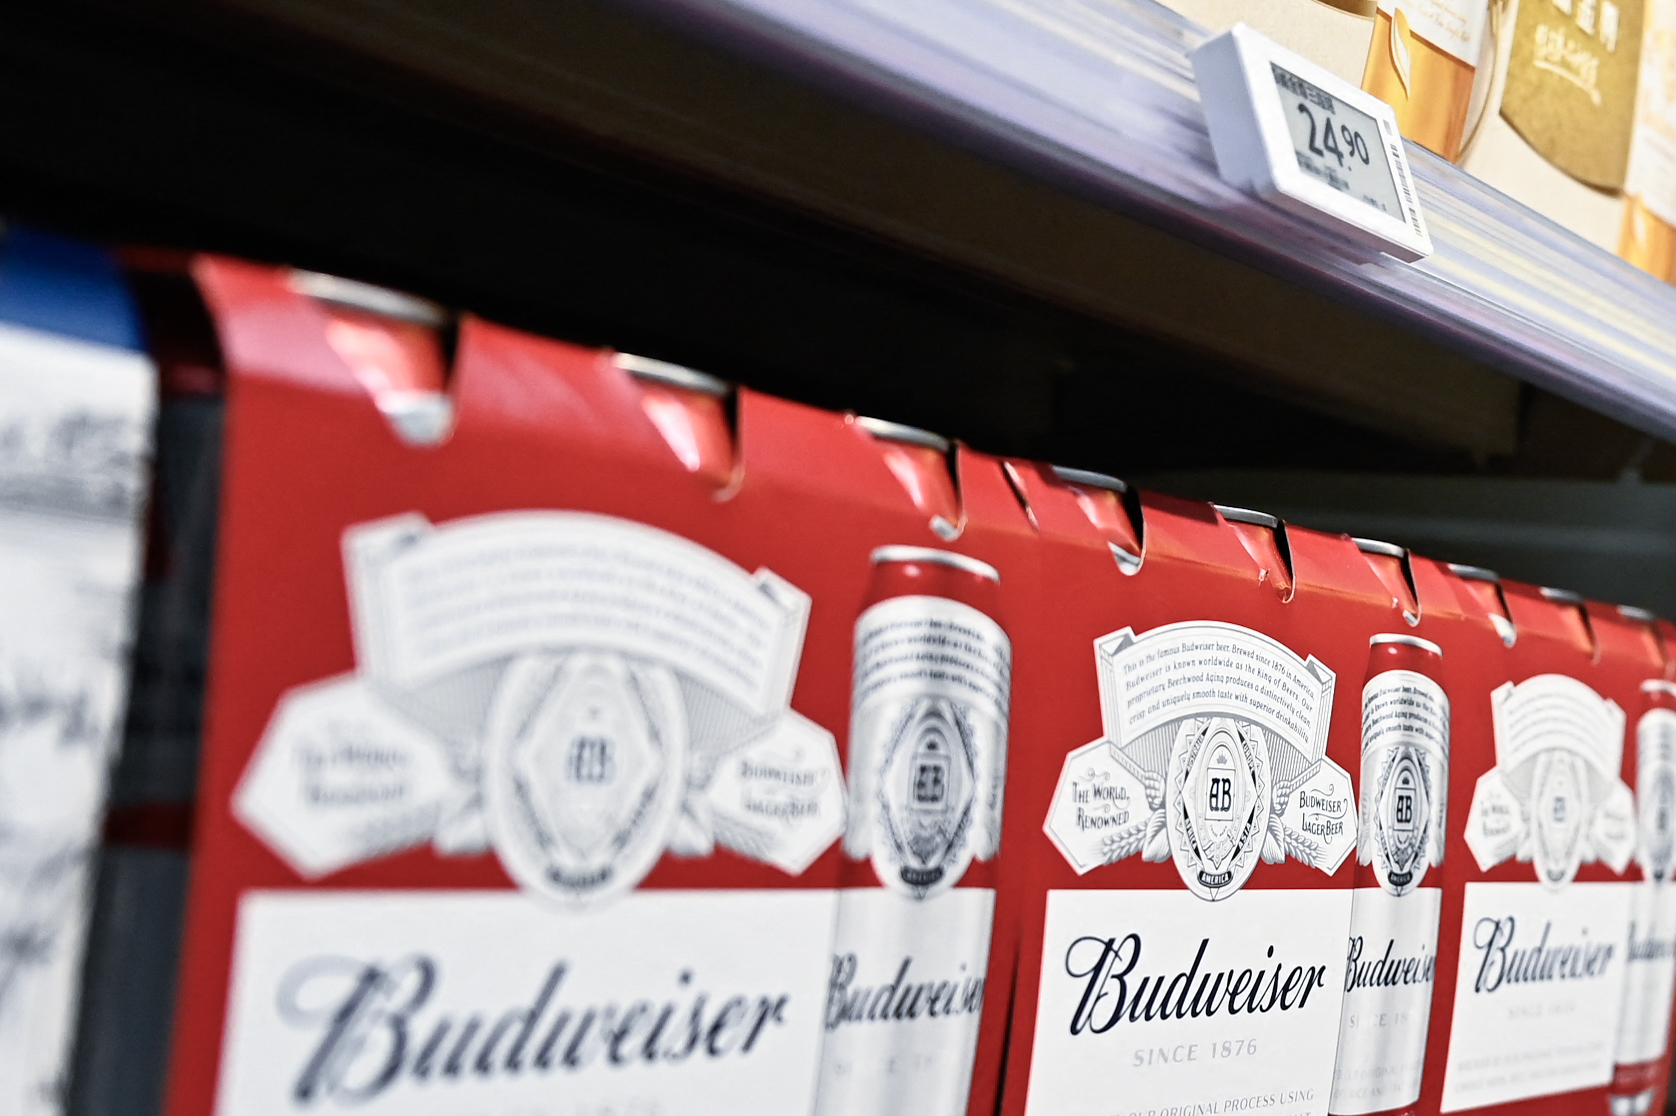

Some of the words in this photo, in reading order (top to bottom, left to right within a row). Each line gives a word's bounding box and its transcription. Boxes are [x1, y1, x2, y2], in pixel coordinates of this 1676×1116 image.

[1181, 641, 1215, 652] Budweiser
[1256, 652, 1270, 666] since
[1271, 660, 1286, 675] 1876
[1198, 655, 1233, 668] worldwide
[1244, 662, 1255, 675] the
[1192, 688, 1215, 699] smooth
[1225, 675, 1253, 690] produces
[1209, 778, 1232, 812] AB
[1300, 791, 1342, 812] BUDWEISER
[1077, 807, 1130, 831] RENOWNED
[1202, 872, 1230, 885] AMERICA
[1474, 916, 1615, 993] Budweiser
[1065, 933, 1326, 1036] Budweiser
[276, 951, 790, 1111] Budweiser
[1133, 1044, 1198, 1067] SINCE
[1211, 1038, 1257, 1059] 1876
[1223, 1093, 1275, 1113] PROCESS
[1280, 1088, 1314, 1105] USING
